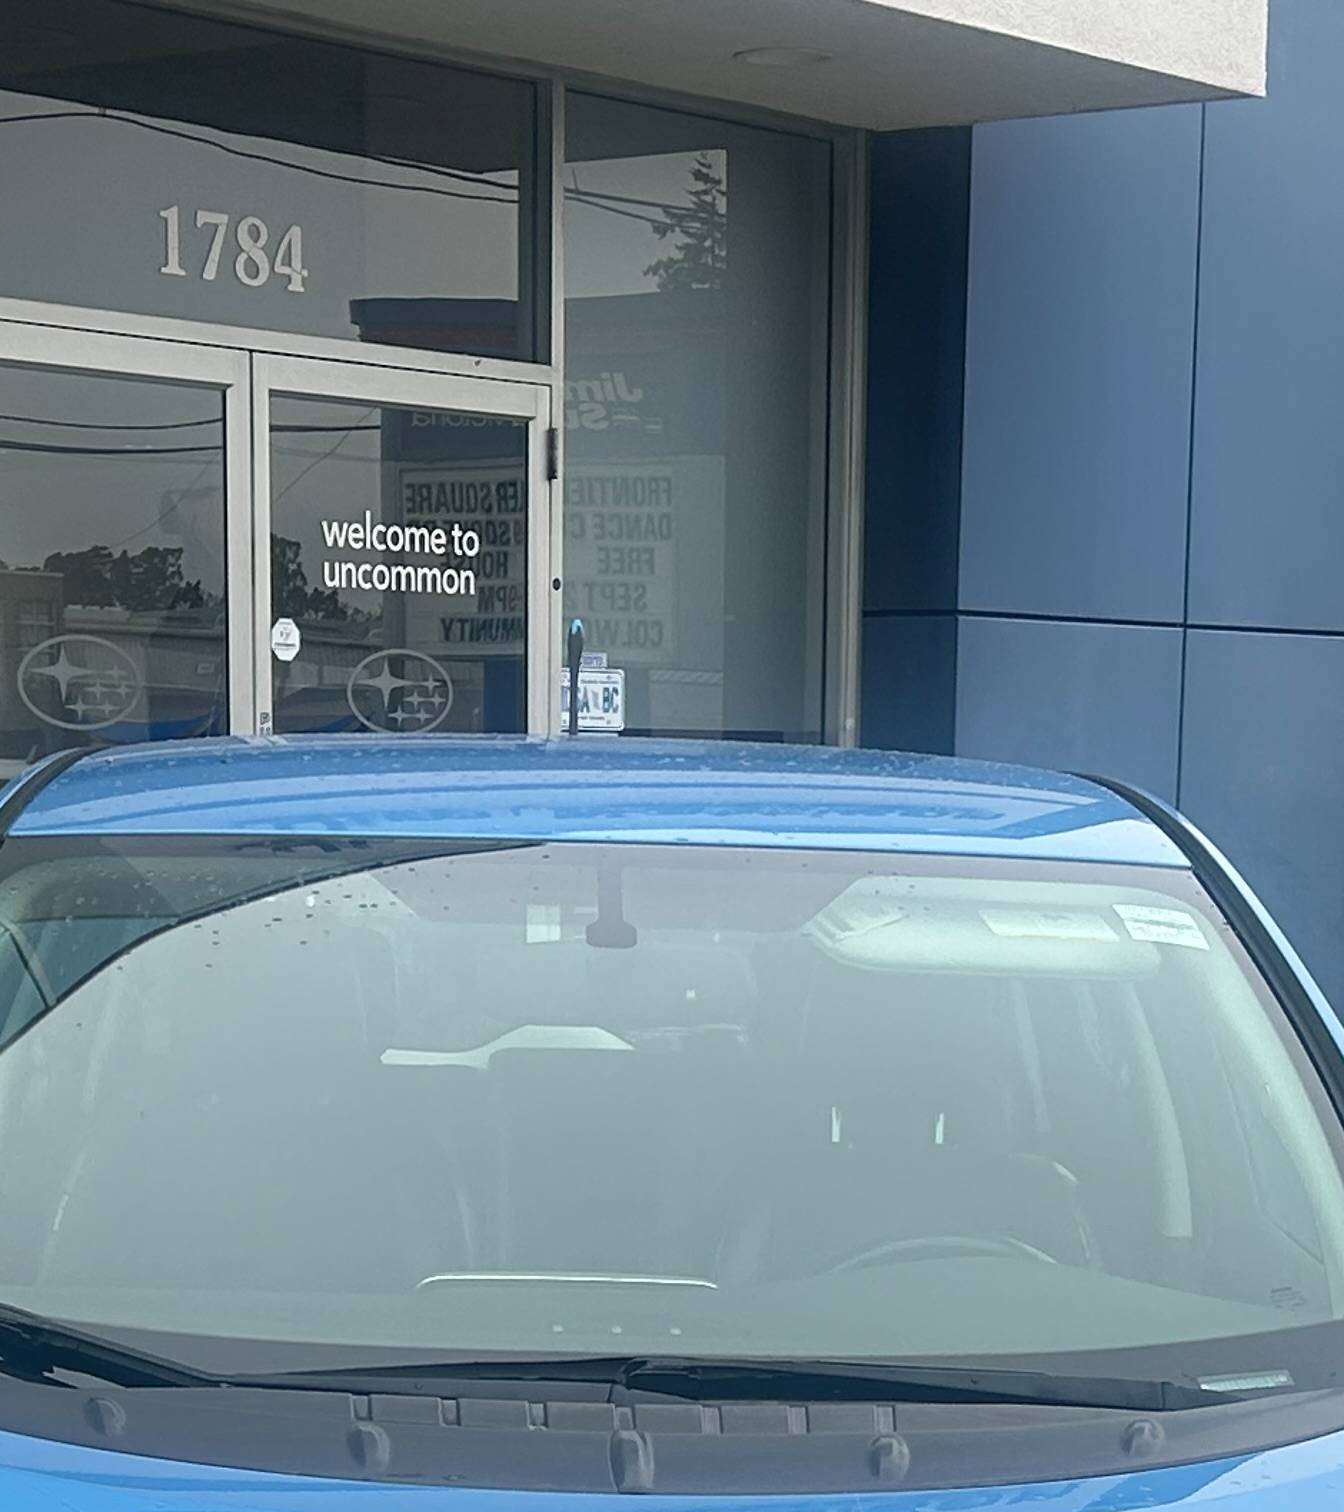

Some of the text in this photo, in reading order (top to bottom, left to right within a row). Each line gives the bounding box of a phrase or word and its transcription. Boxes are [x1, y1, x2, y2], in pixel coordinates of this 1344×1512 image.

[159, 205, 308, 292] 1784
[321, 510, 447, 555] welcome
[451, 523, 480, 557] to
[323, 561, 476, 595] uncommon
